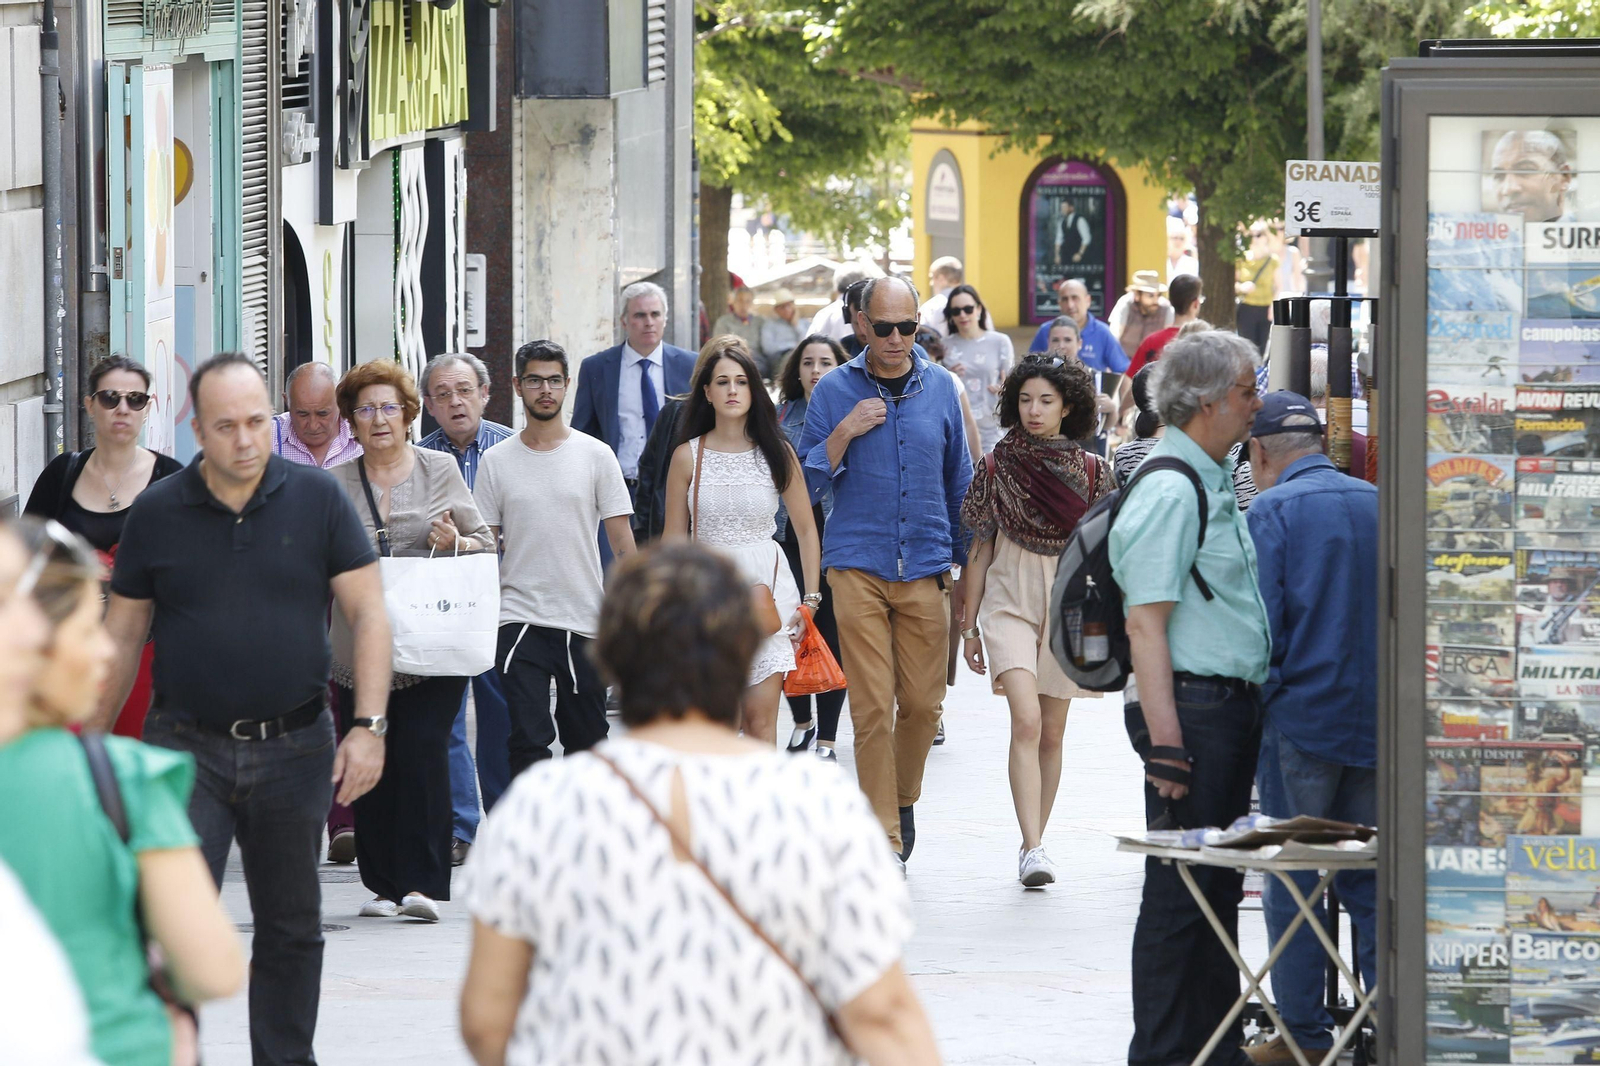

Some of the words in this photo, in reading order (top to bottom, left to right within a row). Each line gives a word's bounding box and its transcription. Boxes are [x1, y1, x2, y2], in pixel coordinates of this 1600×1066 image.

[421, 0, 469, 129] PASTA
[1289, 163, 1381, 183] GRANAD
[1294, 201, 1321, 222] 3€
[1427, 389, 1508, 414] escalar
[1517, 392, 1562, 408] AVION
[410, 599, 477, 613] SUPER
[1521, 837, 1598, 872] vela
